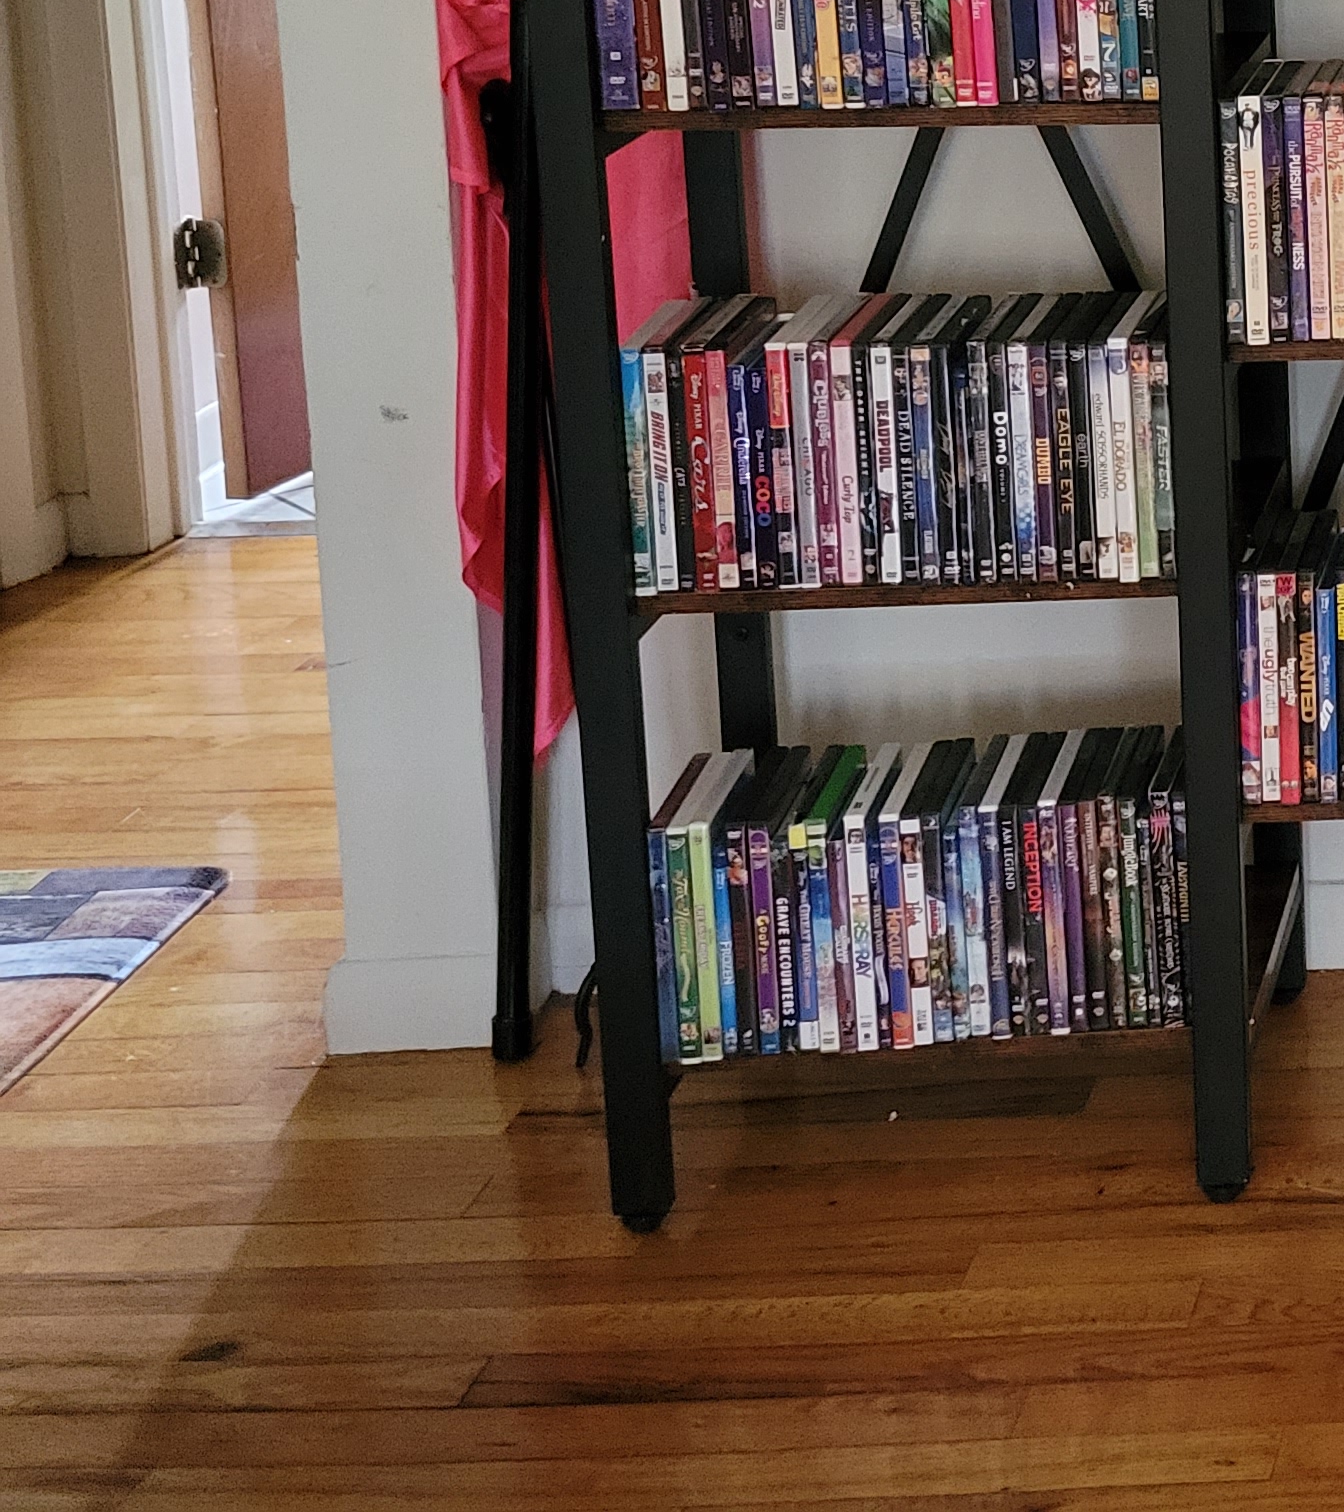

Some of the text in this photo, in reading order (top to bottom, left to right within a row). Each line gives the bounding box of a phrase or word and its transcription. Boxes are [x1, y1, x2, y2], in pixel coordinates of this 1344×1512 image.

[1244, 169, 1262, 250] precious
[693, 403, 704, 429] PIXAR
[876, 400, 892, 473] DEADPOOL
[1076, 433, 1089, 468] earth
[842, 475, 855, 524] Curly Top
[897, 411, 915, 521] DEAD SILENCE
[1056, 408, 1073, 515] EAGLE EYE
[1114, 440, 1127, 492] DORADO
[1299, 631, 1316, 723] WANTED
[1002, 827, 1012, 845] AM
[1003, 847, 1016, 890] LEGEND
[1023, 822, 1043, 913] INCEPTION
[775, 897, 796, 1027] GRAVE ENCOUNTERS 2
[852, 894, 872, 978] HAIRSPRAY
